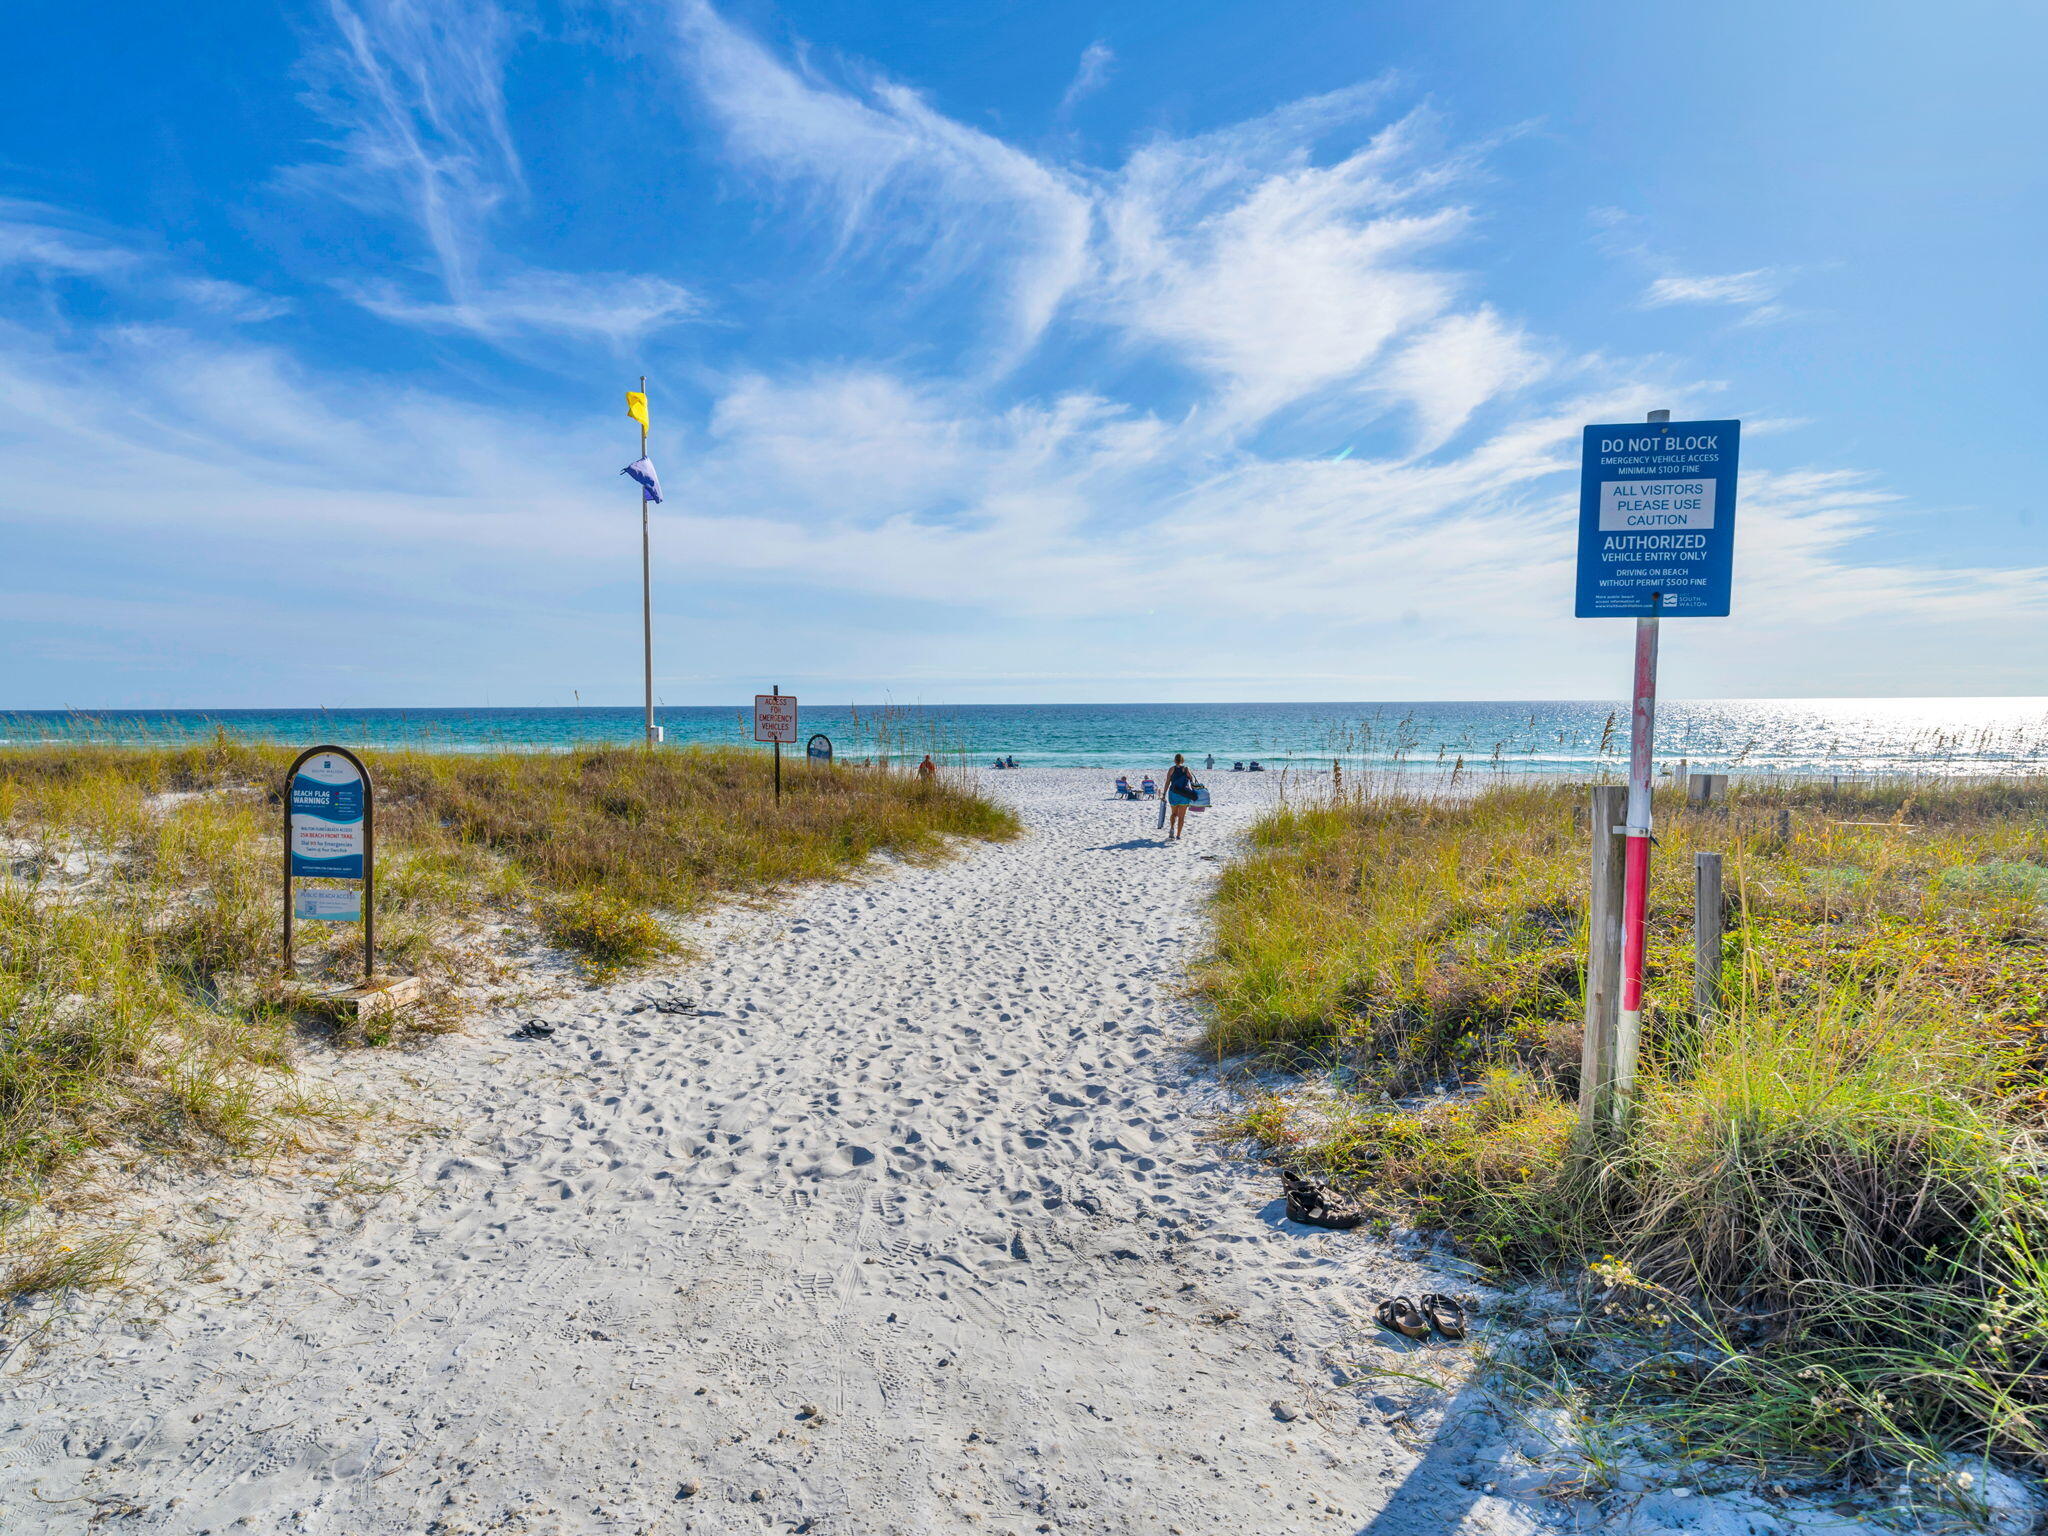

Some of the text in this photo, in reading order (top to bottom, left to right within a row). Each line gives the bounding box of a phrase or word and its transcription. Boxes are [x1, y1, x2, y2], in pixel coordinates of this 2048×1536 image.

[1601, 435, 1718, 452] DO NOT BLOCK
[1600, 453, 1719, 465] EMERGENCY VEHICLE ACCESS
[1618, 464, 1700, 475] MINIMUM $100 FINE
[1613, 483, 1703, 496] ALL VISITORS
[1617, 499, 1702, 512] PLEASE USE
[1627, 514, 1687, 526] CAUTION
[1603, 535, 1706, 550] AUTHORIZED
[1601, 551, 1707, 562] VEHICLE ENTRY ONLY
[1616, 569, 1647, 577] DRIVING
[1662, 568, 1689, 576] BEACH
[1599, 578, 1708, 587] WITHOUT PERMIT $500 FINE
[759, 714, 793, 723] EMERGENCY
[762, 723, 790, 731] VEHICLES
[314, 790, 330, 798] FLAG
[293, 796, 330, 805] WARNINGS
